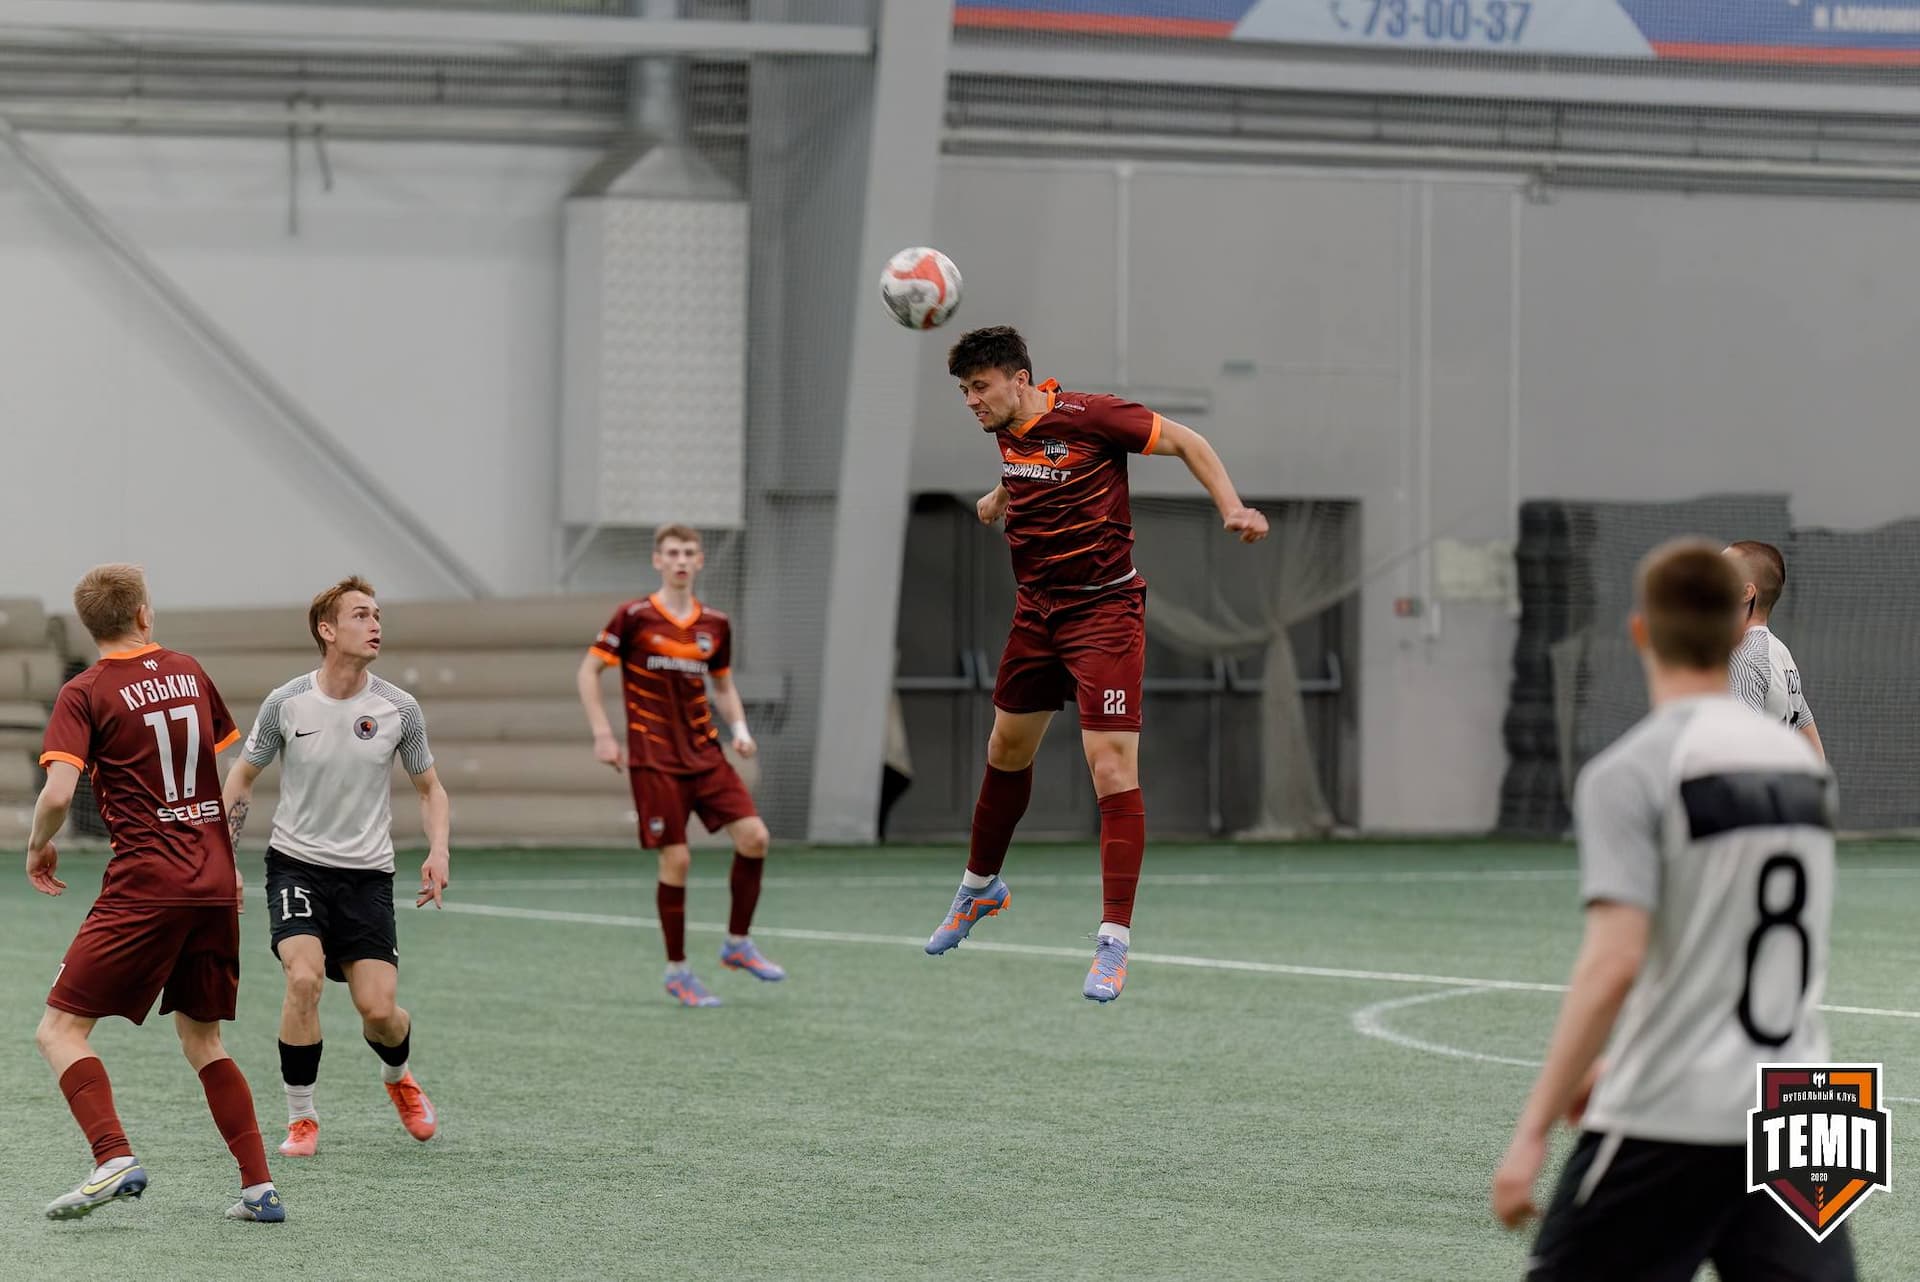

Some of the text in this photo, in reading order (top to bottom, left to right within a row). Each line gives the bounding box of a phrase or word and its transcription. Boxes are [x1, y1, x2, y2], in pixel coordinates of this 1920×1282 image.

[119, 674, 200, 711] КУЗЬКИН
[1103, 689, 1126, 715] 22
[143, 704, 200, 802] 17
[157, 800, 220, 822] SEUS
[280, 886, 312, 920] 15
[1738, 853, 1810, 1048] 8
